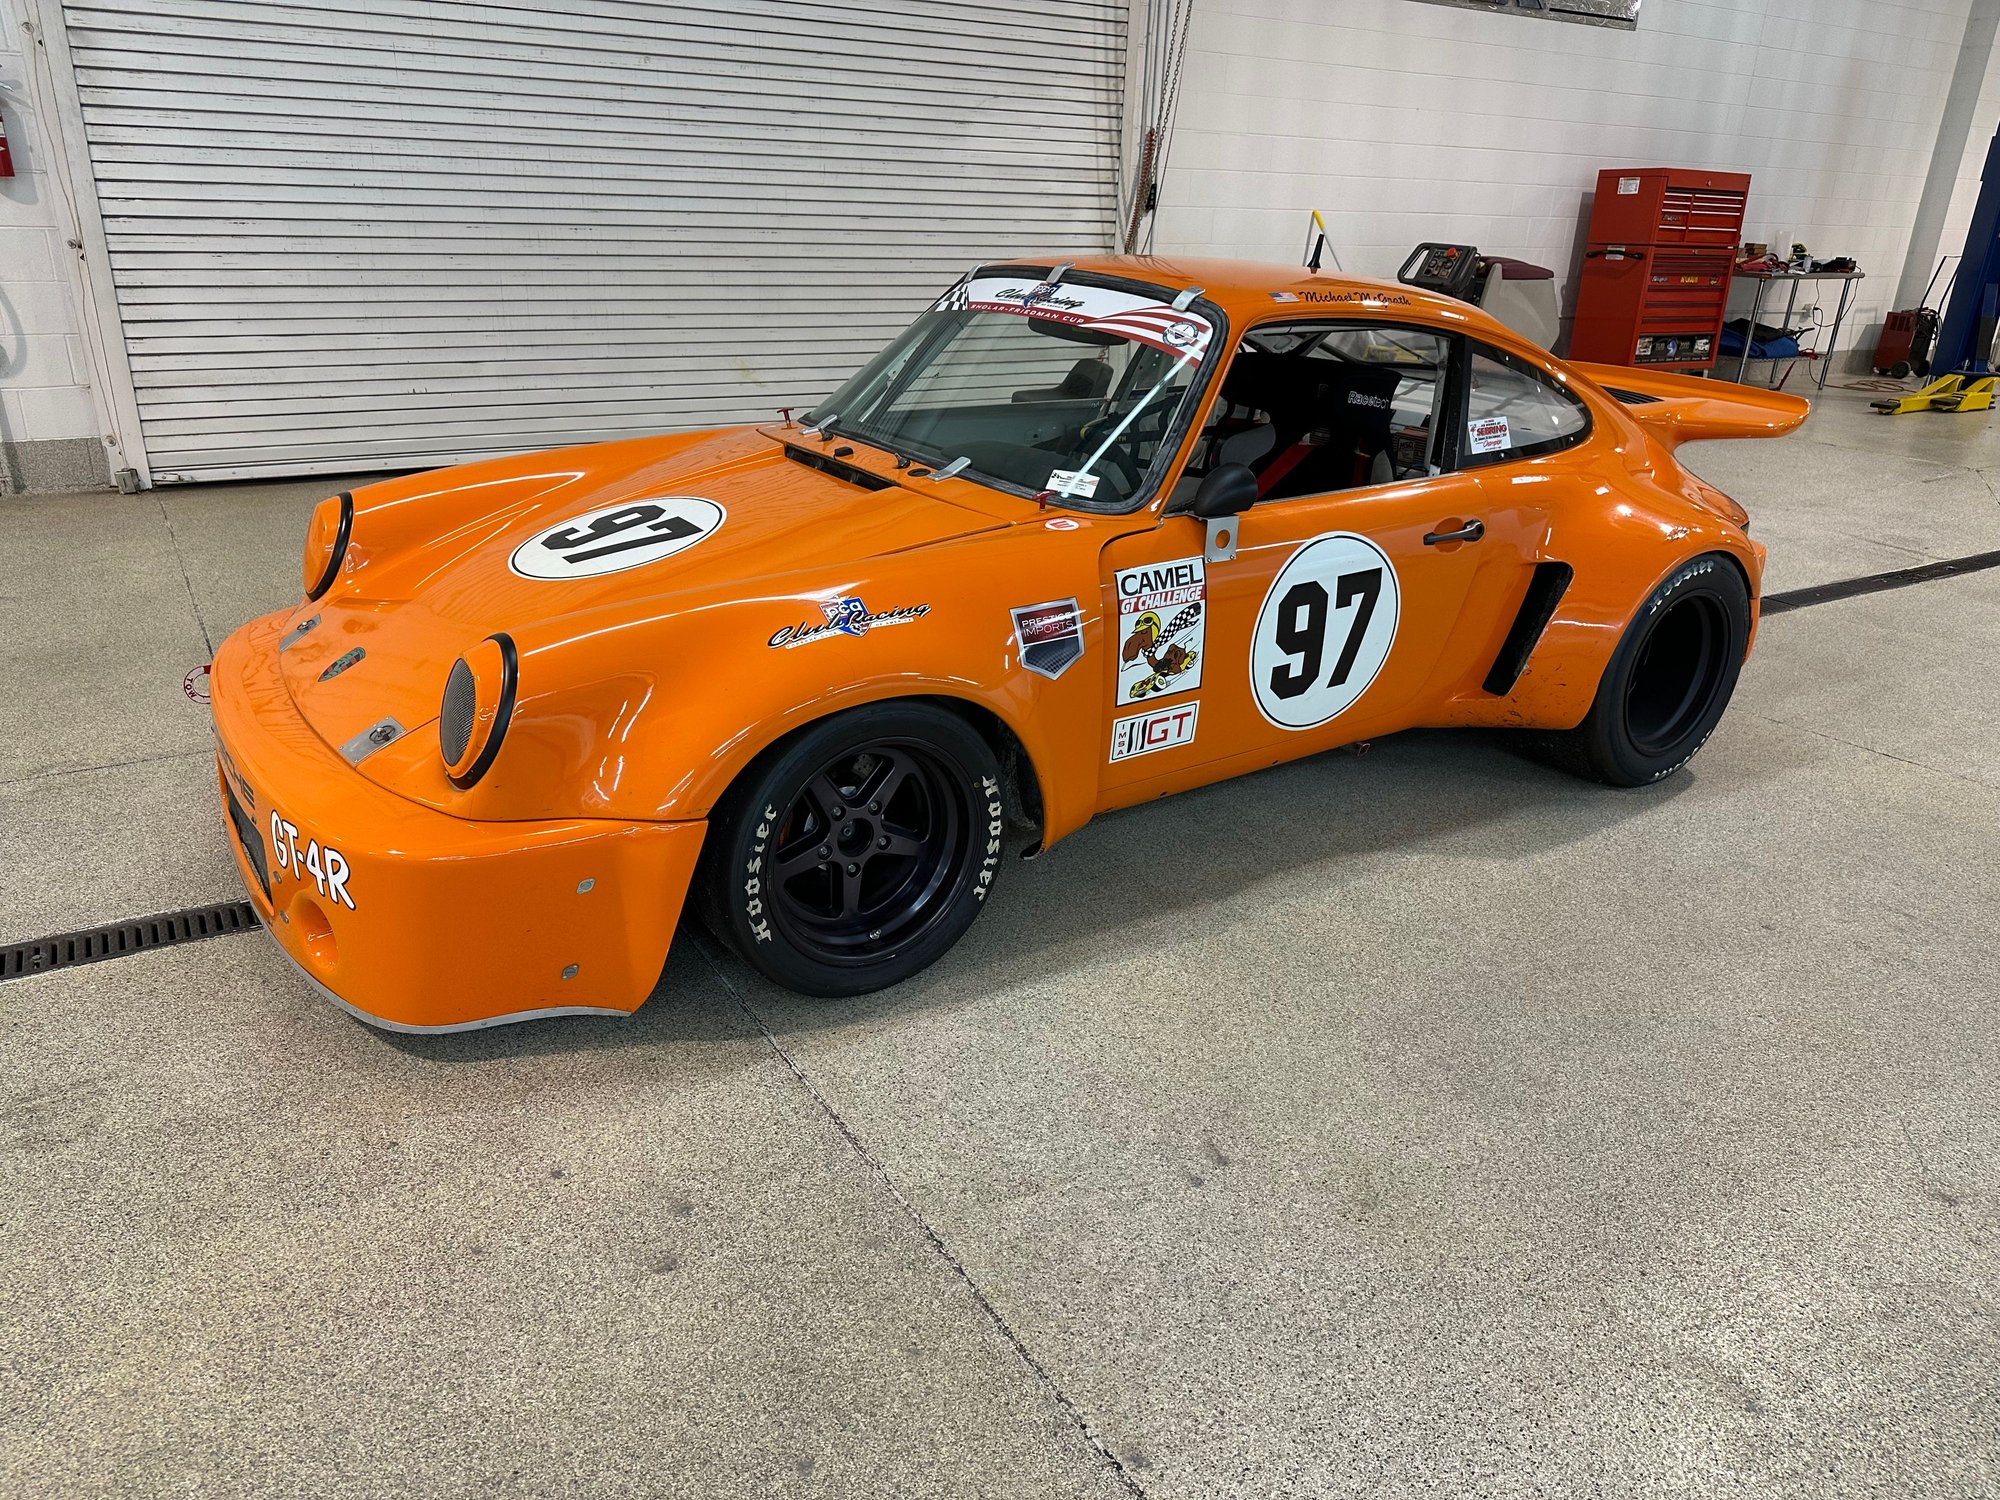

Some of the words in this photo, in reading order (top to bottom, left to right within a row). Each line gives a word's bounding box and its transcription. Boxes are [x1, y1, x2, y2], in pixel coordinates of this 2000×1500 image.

[970, 304, 1060, 319] SHOLAR-FRIEDMAN
[1062, 314, 1085, 324] CUP
[1298, 291, 1355, 302] Michael
[1354, 292, 1412, 308] McGrath
[1477, 424, 1507, 437] SEBRING
[540, 504, 704, 564] 97
[1120, 564, 1203, 596] CAMEL
[826, 600, 863, 619] pca
[1121, 598, 1138, 614] GT
[1138, 585, 1202, 611] CHALLENGE
[767, 613, 843, 648] Club
[845, 603, 932, 628] Racing
[1021, 611, 1072, 628] PRESTIGE
[1023, 620, 1074, 637] IMPORTS
[1269, 567, 1383, 700] 97
[1147, 711, 1192, 745] GT
[973, 773, 1003, 901] Hoosier
[270, 809, 356, 911] GT-4R
[744, 803, 777, 945] Hoosier
